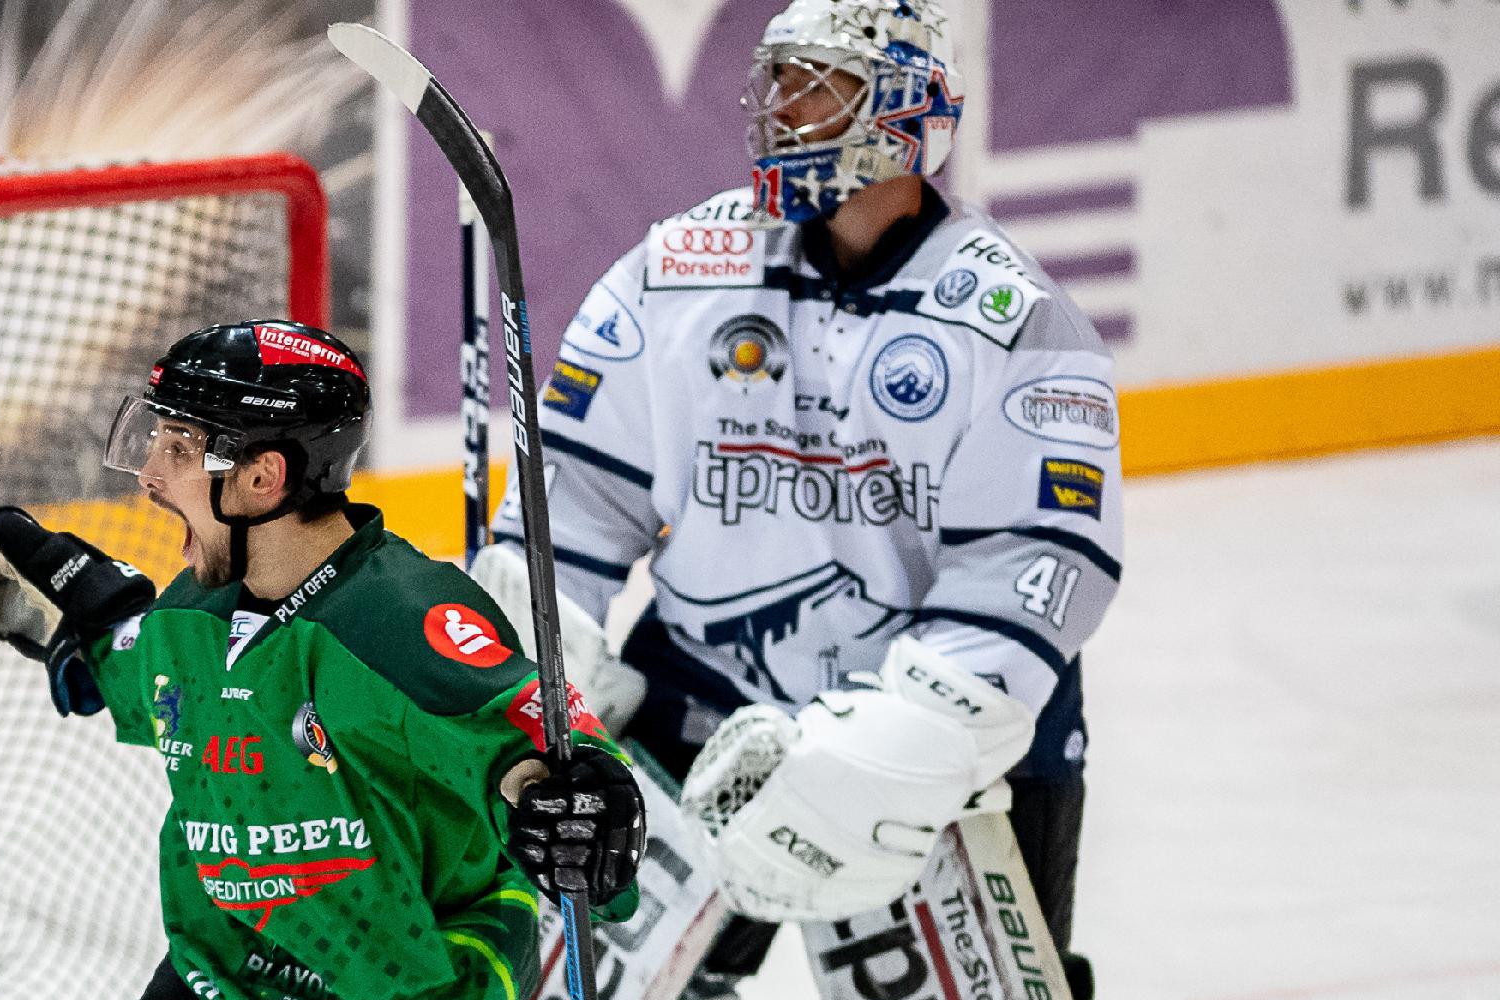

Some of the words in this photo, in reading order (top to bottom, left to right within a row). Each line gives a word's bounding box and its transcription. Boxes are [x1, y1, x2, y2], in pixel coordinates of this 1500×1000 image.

[662, 256, 750, 275] Porsche
[260, 327, 341, 366] Internorm
[501, 291, 530, 457] BAUER
[241, 395, 297, 410] BAUER
[718, 418, 758, 436] The
[828, 430, 887, 459] Cpany
[274, 588, 307, 623] PLAY
[303, 564, 338, 596] OFFS
[1016, 554, 1079, 629] 41
[907, 665, 982, 715] CCM
[201, 735, 265, 776] AEG
[180, 820, 238, 855] WIG
[247, 816, 372, 856] PEETZ
[942, 892, 975, 956] The
